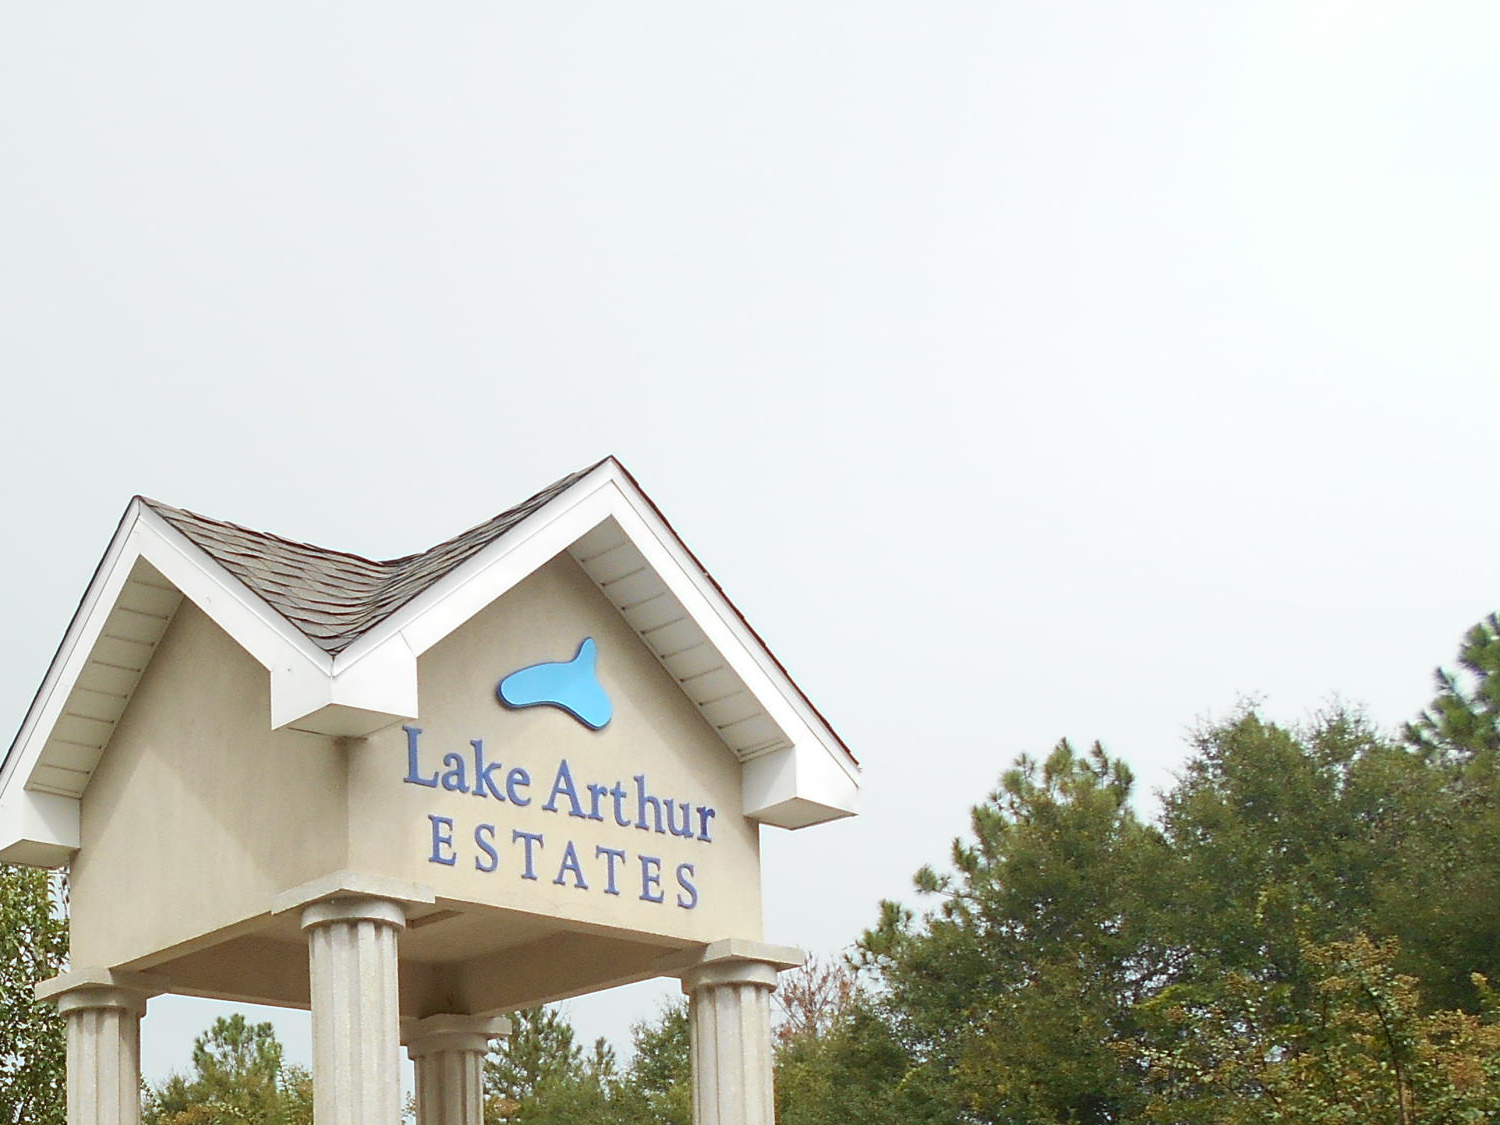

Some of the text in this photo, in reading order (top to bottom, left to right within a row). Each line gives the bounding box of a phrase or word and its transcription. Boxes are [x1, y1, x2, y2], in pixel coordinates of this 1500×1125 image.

[402, 725, 716, 843] Lake Arthur
[427, 813, 699, 910] ESTATES
